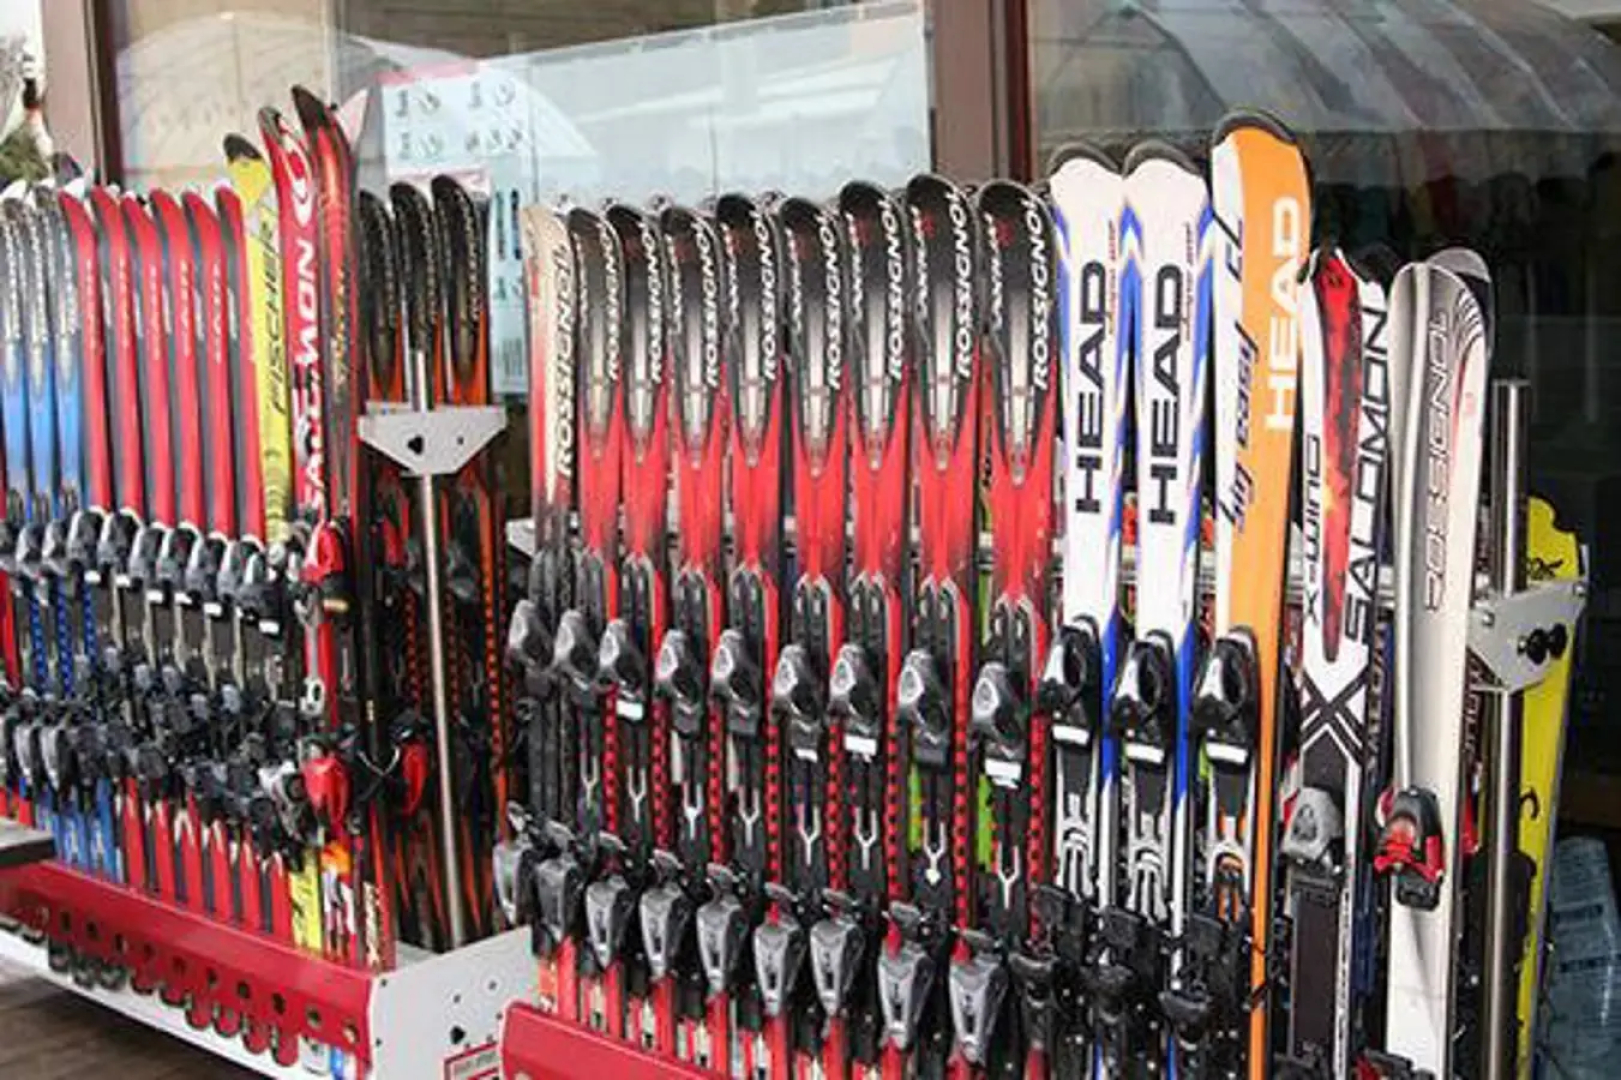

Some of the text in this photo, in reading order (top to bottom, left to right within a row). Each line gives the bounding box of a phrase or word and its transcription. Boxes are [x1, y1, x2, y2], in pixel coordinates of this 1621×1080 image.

[259, 220, 286, 416] FISCHER
[552, 243, 573, 478] ROSSIGNOL
[945, 187, 973, 379] ROSSIGNOL
[1022, 193, 1050, 391] ROSSIGNOL
[1075, 259, 1106, 514] HEAD
[1148, 263, 1183, 525] HEAD
[1234, 319, 1259, 449] easy
[1264, 196, 1300, 431] HEAD
[1345, 305, 1388, 647] SALOMON
